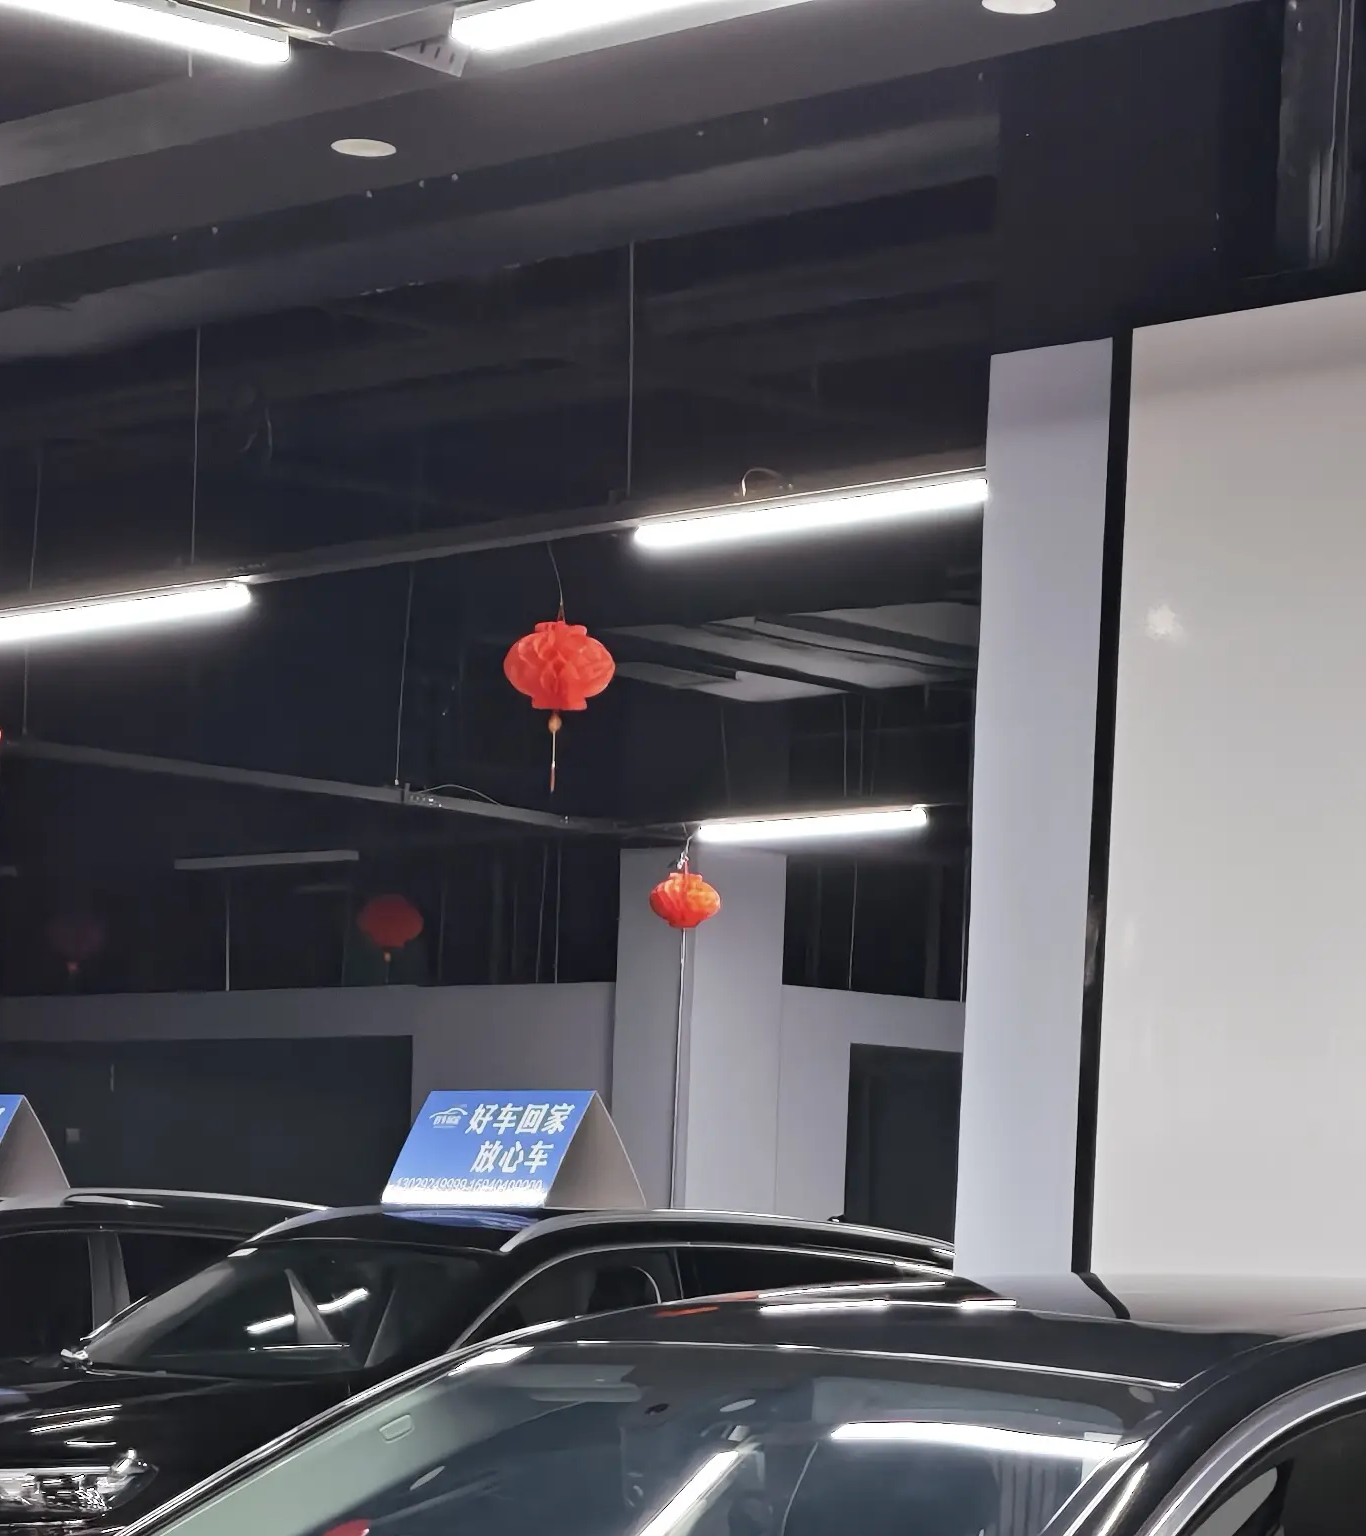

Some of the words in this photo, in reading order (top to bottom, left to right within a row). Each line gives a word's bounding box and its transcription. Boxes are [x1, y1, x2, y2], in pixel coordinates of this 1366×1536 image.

[465, 1102, 575, 1135] 好车回家
[470, 1140, 554, 1174] 放心车
